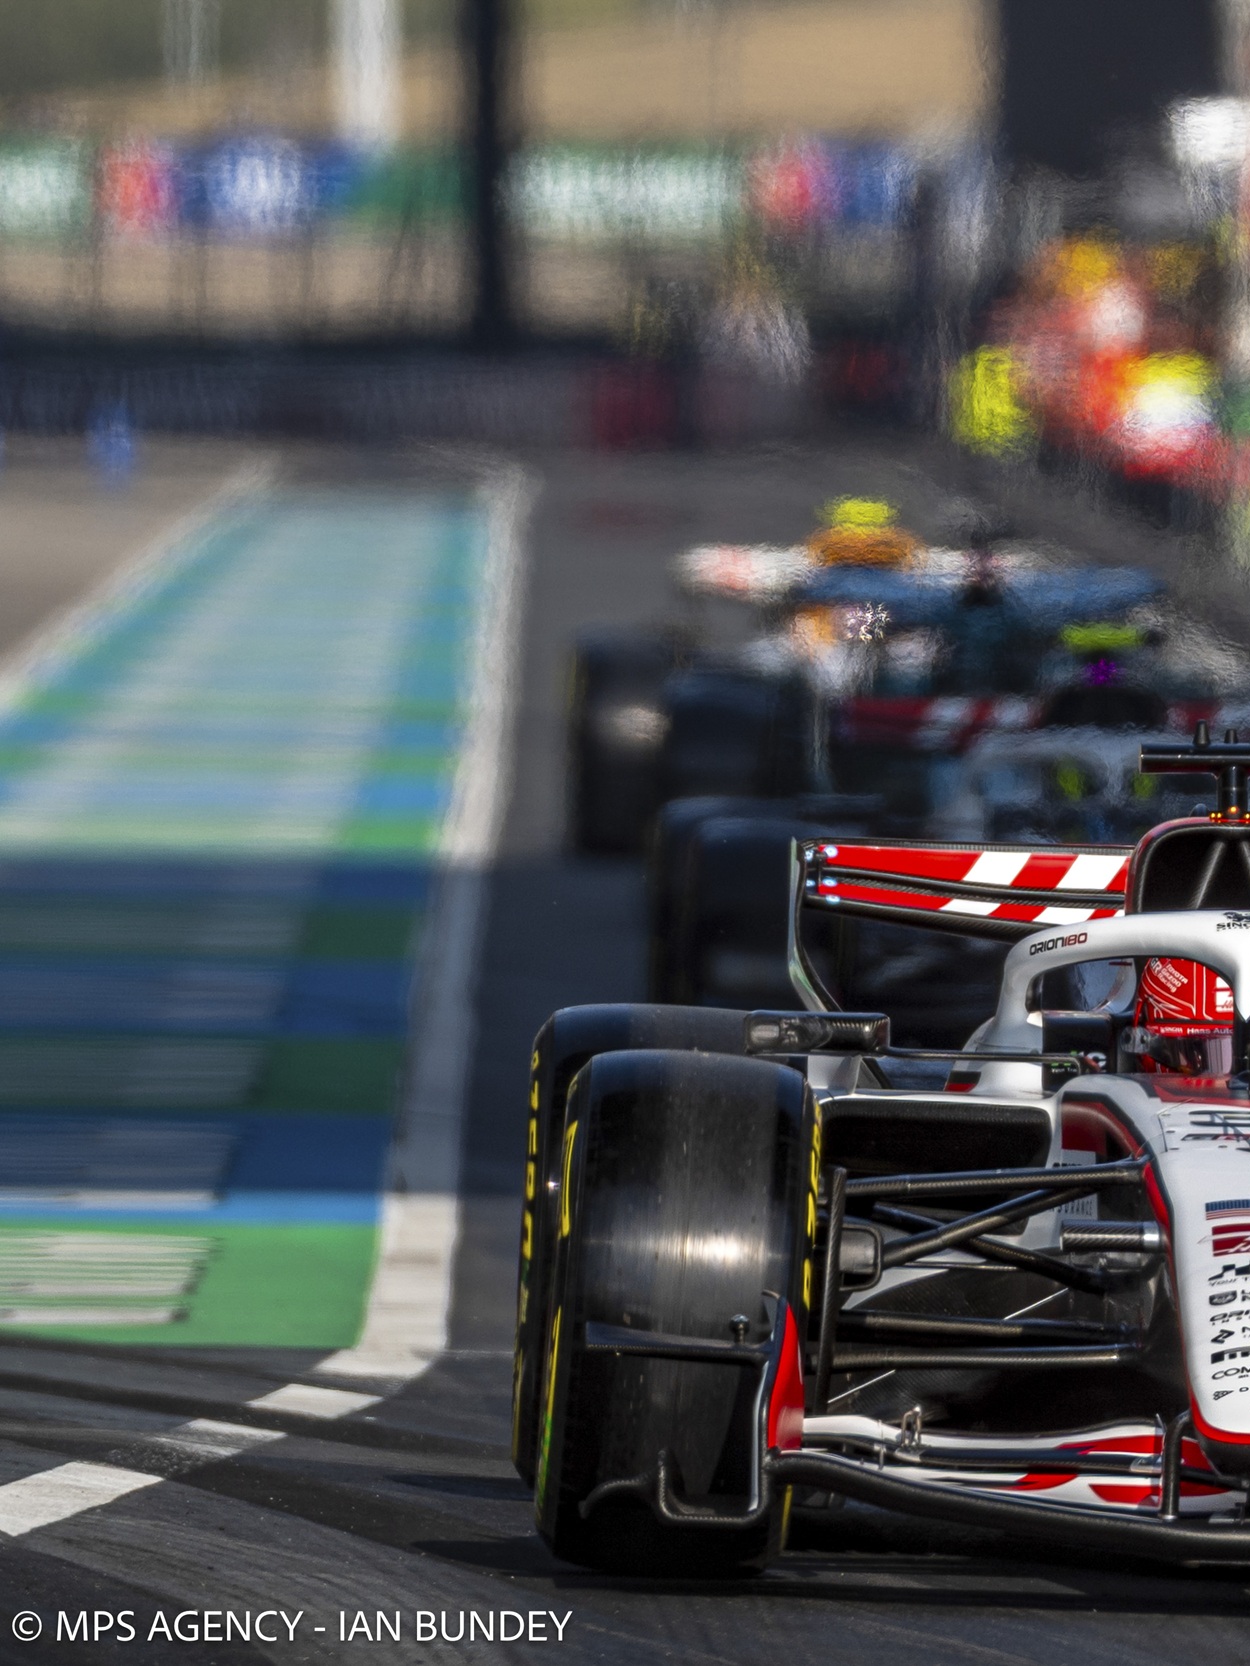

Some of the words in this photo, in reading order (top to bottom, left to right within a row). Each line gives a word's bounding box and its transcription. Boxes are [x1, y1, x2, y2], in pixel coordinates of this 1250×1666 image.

[1029, 932, 1088, 956] ORION180
[1161, 967, 1182, 988] GAZOO
[1166, 963, 1189, 984] TOYOTA
[1209, 1278, 1239, 1287] Your
